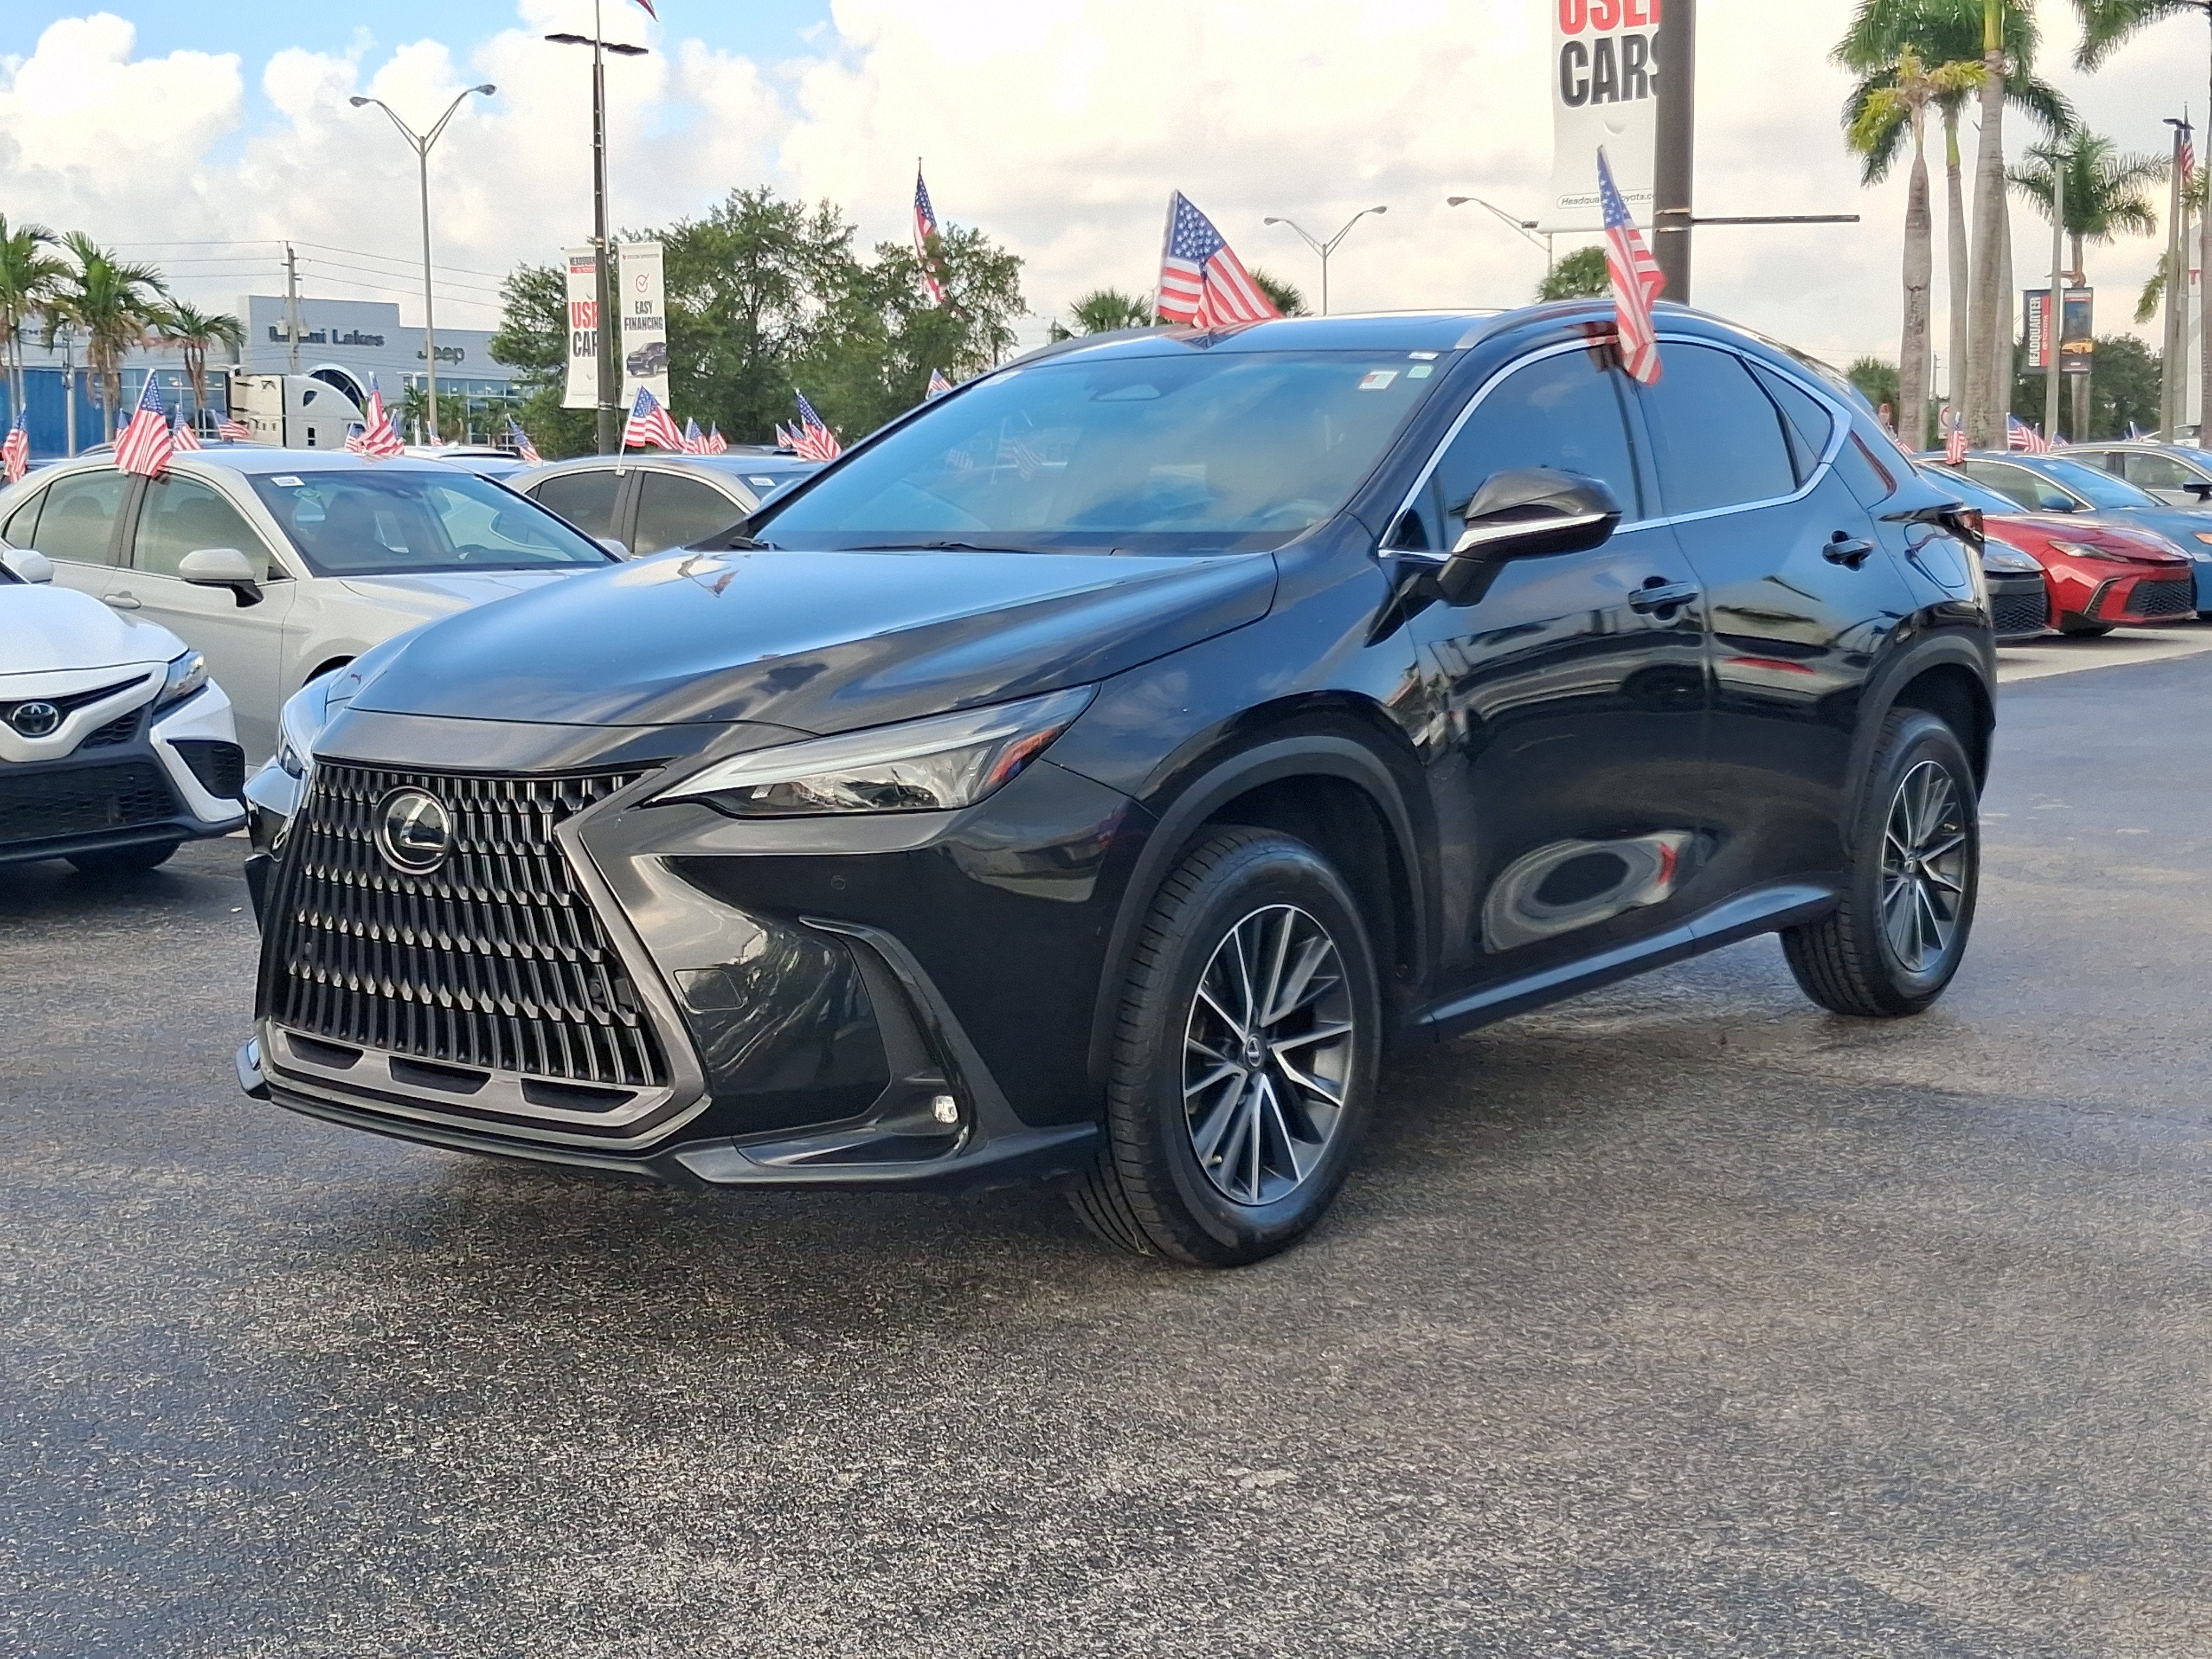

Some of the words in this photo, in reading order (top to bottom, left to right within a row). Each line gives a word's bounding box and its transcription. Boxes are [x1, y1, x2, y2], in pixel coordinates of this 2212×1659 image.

[571, 301, 599, 329] USE
[635, 300, 653, 314] EASY
[624, 317, 663, 331] FINANCING
[2029, 297, 2041, 366] HEADQUARTER
[332, 329, 384, 346] Lakes
[573, 331, 598, 357] CAR
